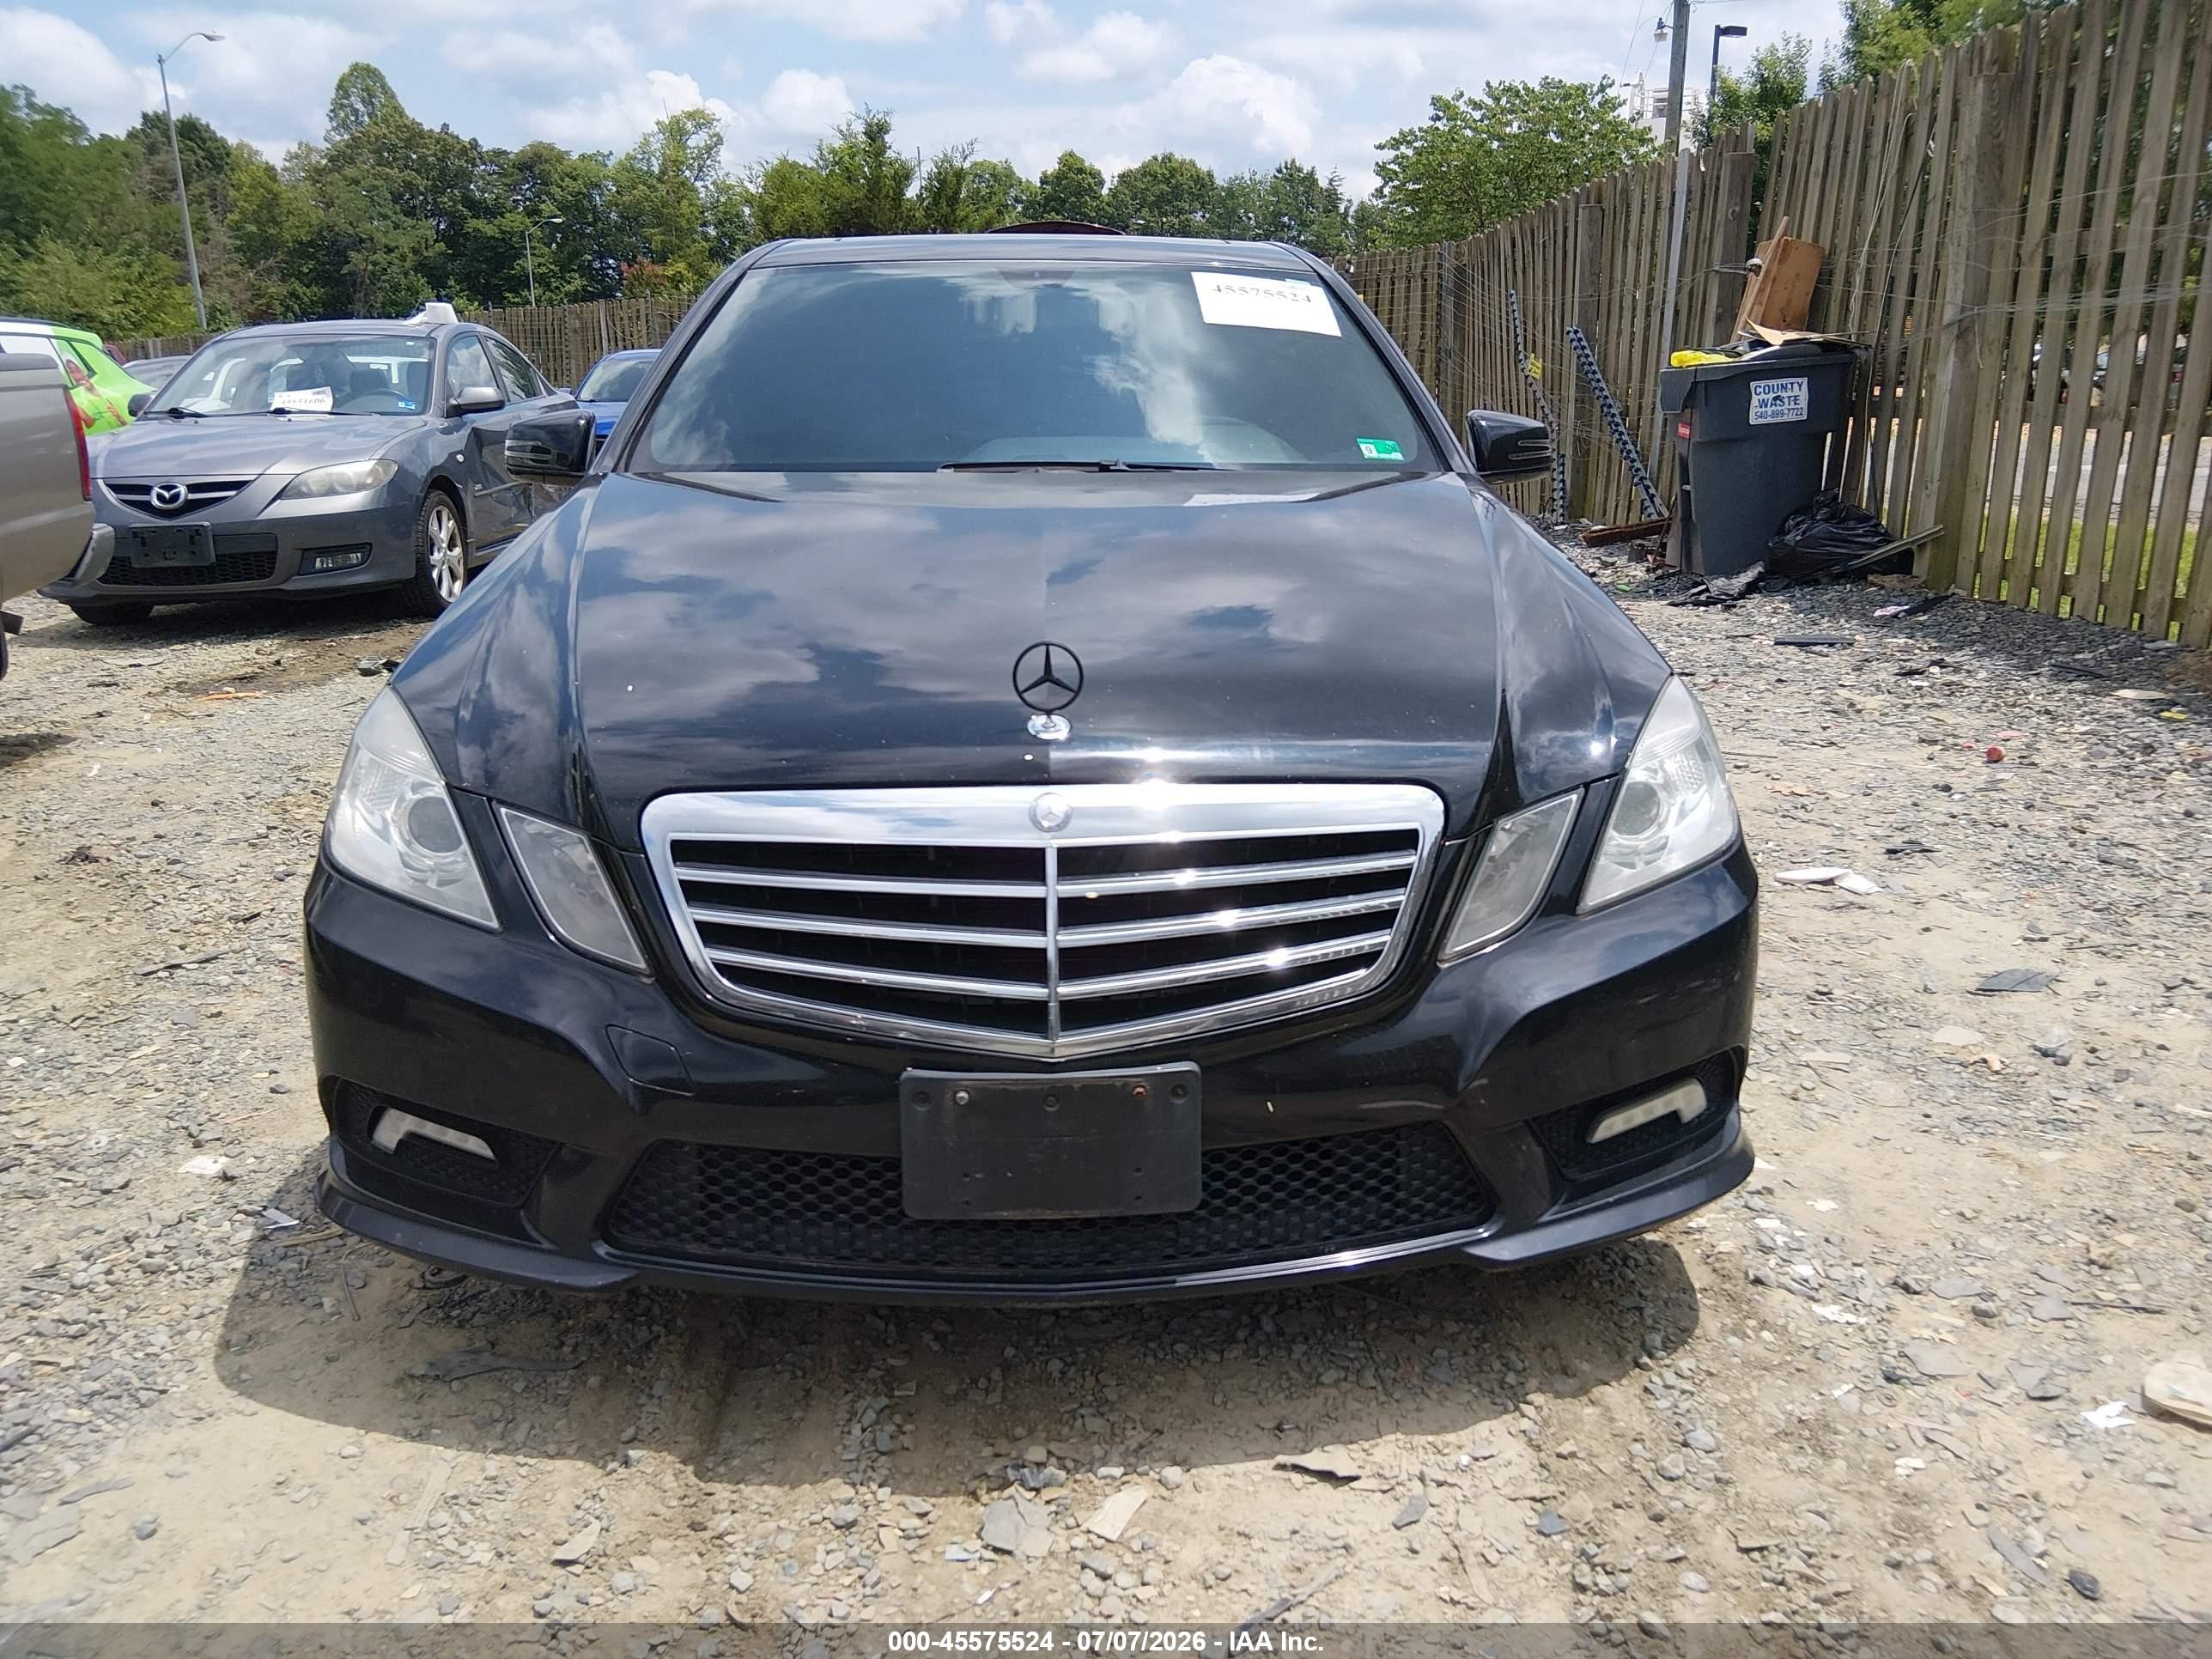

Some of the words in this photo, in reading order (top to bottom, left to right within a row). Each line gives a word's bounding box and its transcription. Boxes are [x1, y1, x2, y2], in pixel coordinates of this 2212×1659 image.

[1212, 284, 1313, 303] 45575524
[1753, 381, 1804, 396] COUNTY
[1758, 395, 1800, 409] WASTE
[1754, 407, 1804, 421] 540-899-7722
